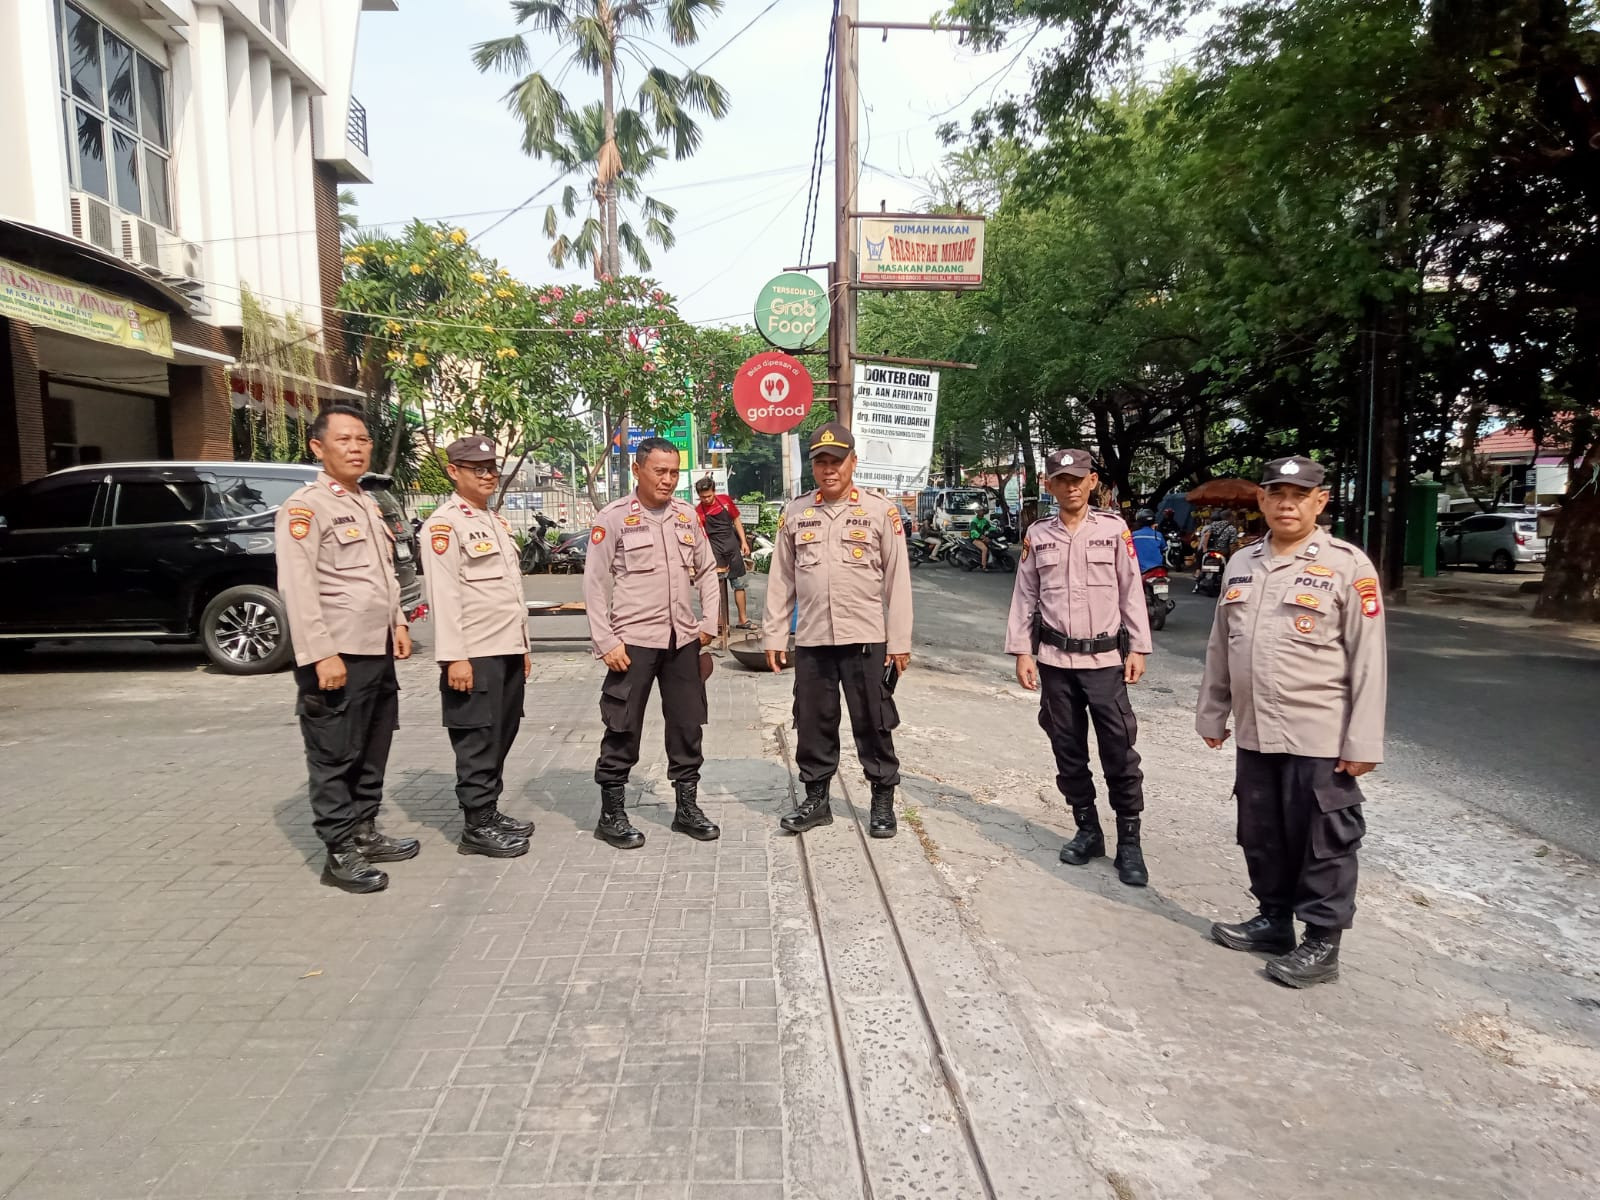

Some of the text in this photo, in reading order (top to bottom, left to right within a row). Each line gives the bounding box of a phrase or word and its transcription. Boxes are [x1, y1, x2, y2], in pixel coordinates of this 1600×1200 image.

[894, 225, 969, 234] RUMAH MAKAN
[942, 237, 976, 262] MINANG
[877, 264, 964, 273] MASAKAN PADANG
[6, 287, 56, 307] MASAKAN
[772, 286, 806, 296] TERSEDIA
[770, 298, 816, 316] Grab
[768, 316, 816, 334] Food
[747, 360, 800, 376] Bisa dipesan di
[864, 368, 930, 387] DOKTER GIGI
[858, 386, 933, 402] drg. AAN AFRIYANTO
[748, 404, 805, 421] gofood
[872, 413, 892, 424] FITRIA
[674, 522, 692, 530] POLRI
[846, 519, 871, 527] POLRI
[469, 531, 488, 540] ATA
[1294, 577, 1335, 591] POLRI
